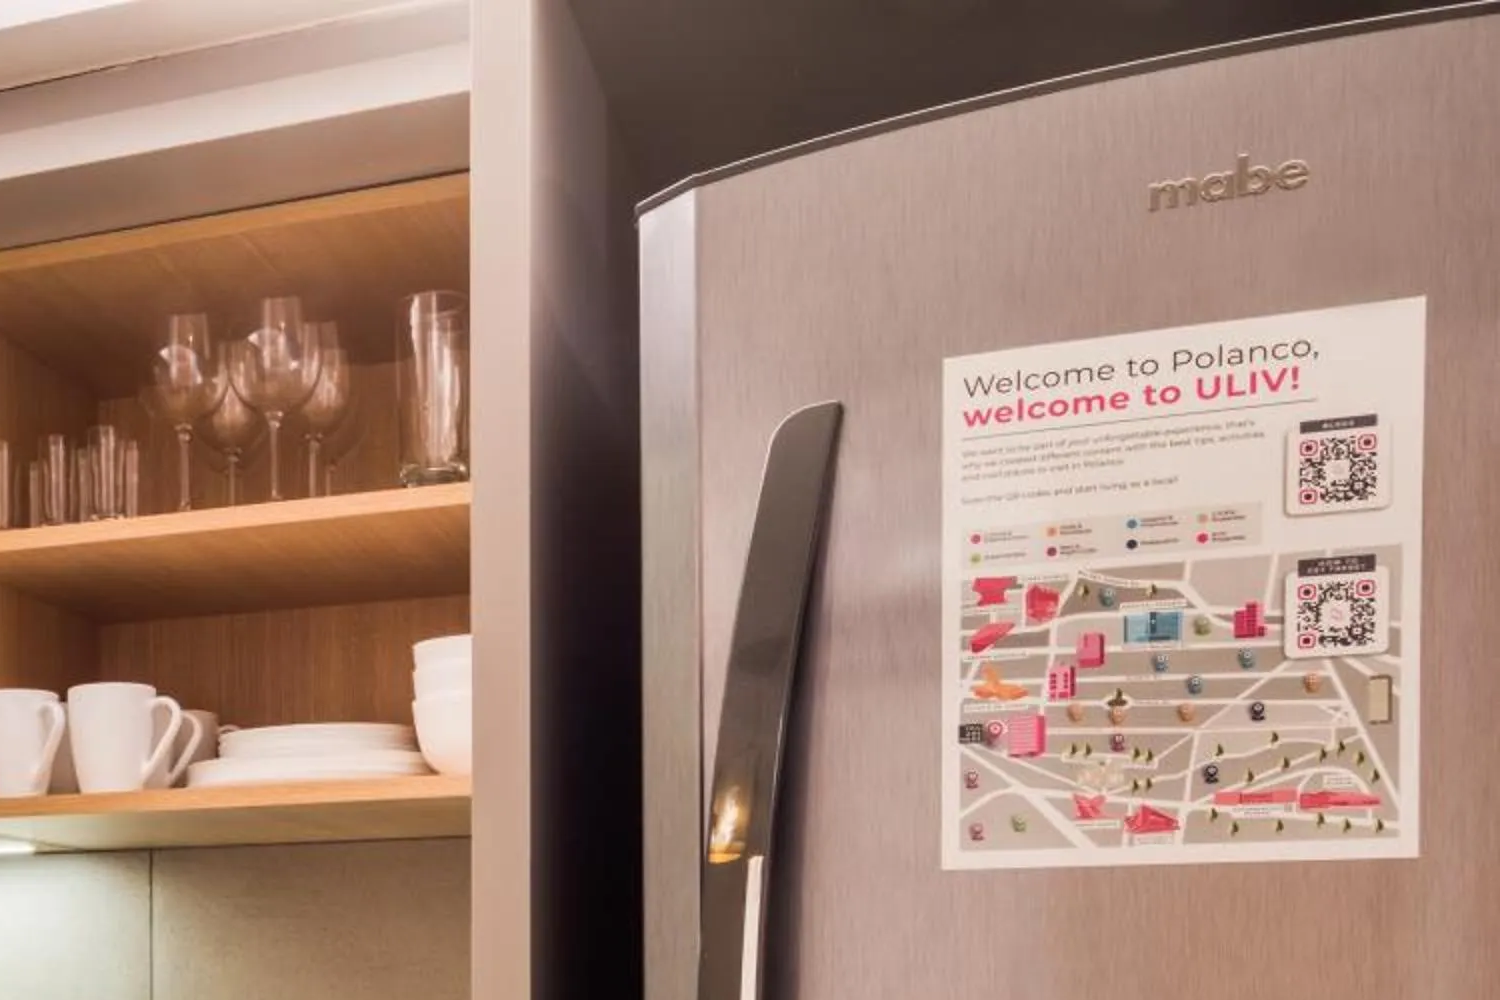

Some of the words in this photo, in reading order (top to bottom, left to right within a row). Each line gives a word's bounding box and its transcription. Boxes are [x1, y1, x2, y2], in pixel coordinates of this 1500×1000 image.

[1147, 152, 1309, 213] mabe
[963, 364, 1116, 398] Welcome
[1126, 359, 1160, 378] to
[1172, 340, 1319, 372] Polanco,
[963, 390, 1131, 427] welcome
[1142, 384, 1182, 406] to
[1195, 366, 1300, 400] ULIV!
